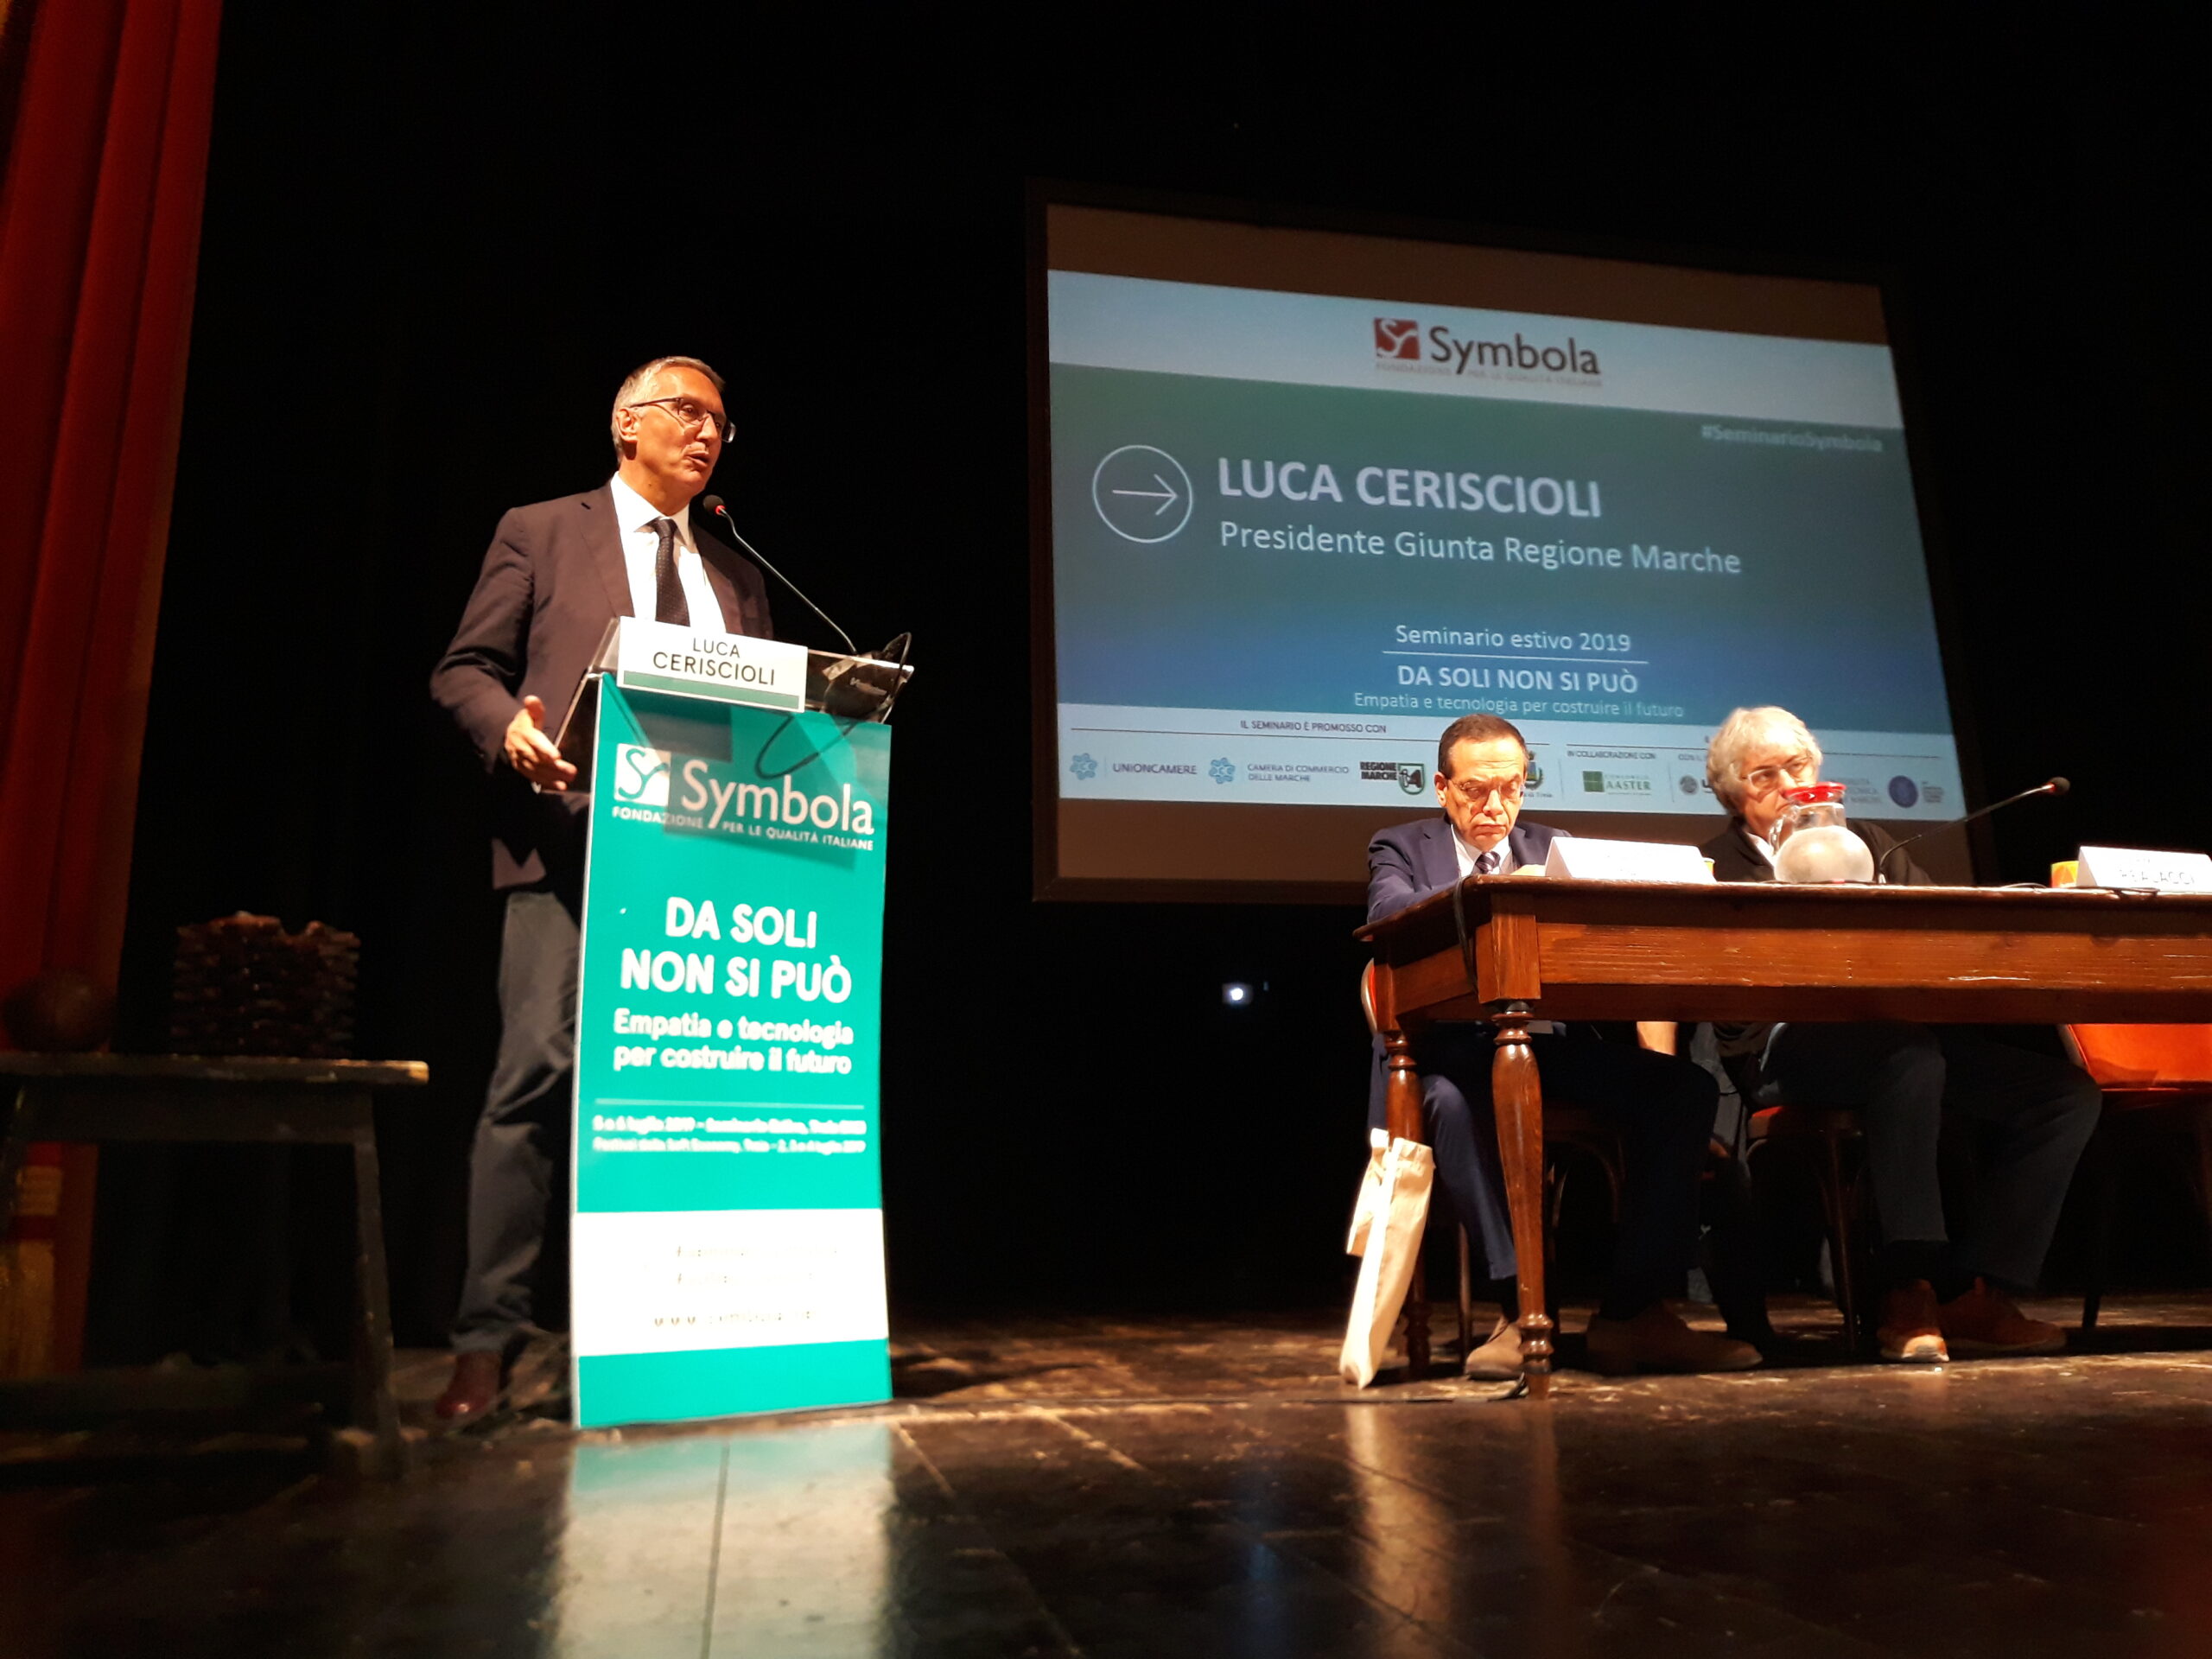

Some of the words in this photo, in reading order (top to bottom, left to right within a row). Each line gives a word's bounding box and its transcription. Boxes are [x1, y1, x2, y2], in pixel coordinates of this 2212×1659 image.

[1429, 326, 1601, 374] Symbola
[1218, 457, 1342, 503] LUCA
[1356, 467, 1602, 518] CERISCIOLI
[1221, 521, 1384, 555] Presidente
[1395, 531, 1493, 562] Giunta
[1504, 537, 1622, 570] Regione
[1631, 543, 1741, 573] Marche
[692, 638, 741, 658] LUCA
[1395, 624, 1504, 648] Seminario
[1510, 632, 1573, 651] estivo
[1579, 632, 1631, 652] 2019
[652, 652, 775, 686] CERISCIOLI
[1397, 665, 1433, 686] DA
[1439, 667, 1491, 689] SOLI
[1498, 669, 1553, 690] NON
[1560, 671, 1580, 691] SI
[1587, 669, 1637, 693] PUÒ
[1354, 692, 1419, 709] Empatia
[1424, 697, 1433, 709] e
[1437, 696, 1518, 715] tecnologia
[1523, 701, 1548, 716] per
[1552, 700, 1619, 715] costruire
[1624, 701, 1632, 715] il
[1637, 702, 1684, 718] futuro
[1241, 721, 1249, 729] IL
[1251, 721, 1301, 731] SEMINARIO
[1312, 722, 1363, 733] PROMOSSO
[1365, 724, 1387, 734] CON
[1112, 763, 1198, 775] UNIONCAMERE
[1248, 763, 1282, 772] CAMERA
[1296, 765, 1349, 774] COMMERCIO
[1360, 761, 1397, 772] REGIONE
[681, 760, 874, 836] Symbola
[612, 806, 704, 830] FONDAZIONE
[722, 822, 744, 835] PER
[748, 825, 761, 836] LE
[766, 827, 819, 844] QUALITÀ
[823, 835, 874, 851] ITALIANE
[665, 897, 721, 940] DA
[730, 903, 817, 949] SOLI
[620, 948, 715, 995] NON
[724, 957, 760, 997] SI
[771, 955, 853, 1003] PUÒ
[613, 1007, 711, 1040] Empatia
[716, 1020, 733, 1039] e
[737, 1016, 854, 1050] tecnologia
[613, 1046, 657, 1071] per
[660, 1045, 764, 1071] costruire
[768, 1047, 782, 1071] il
[786, 1048, 852, 1074] futuro
